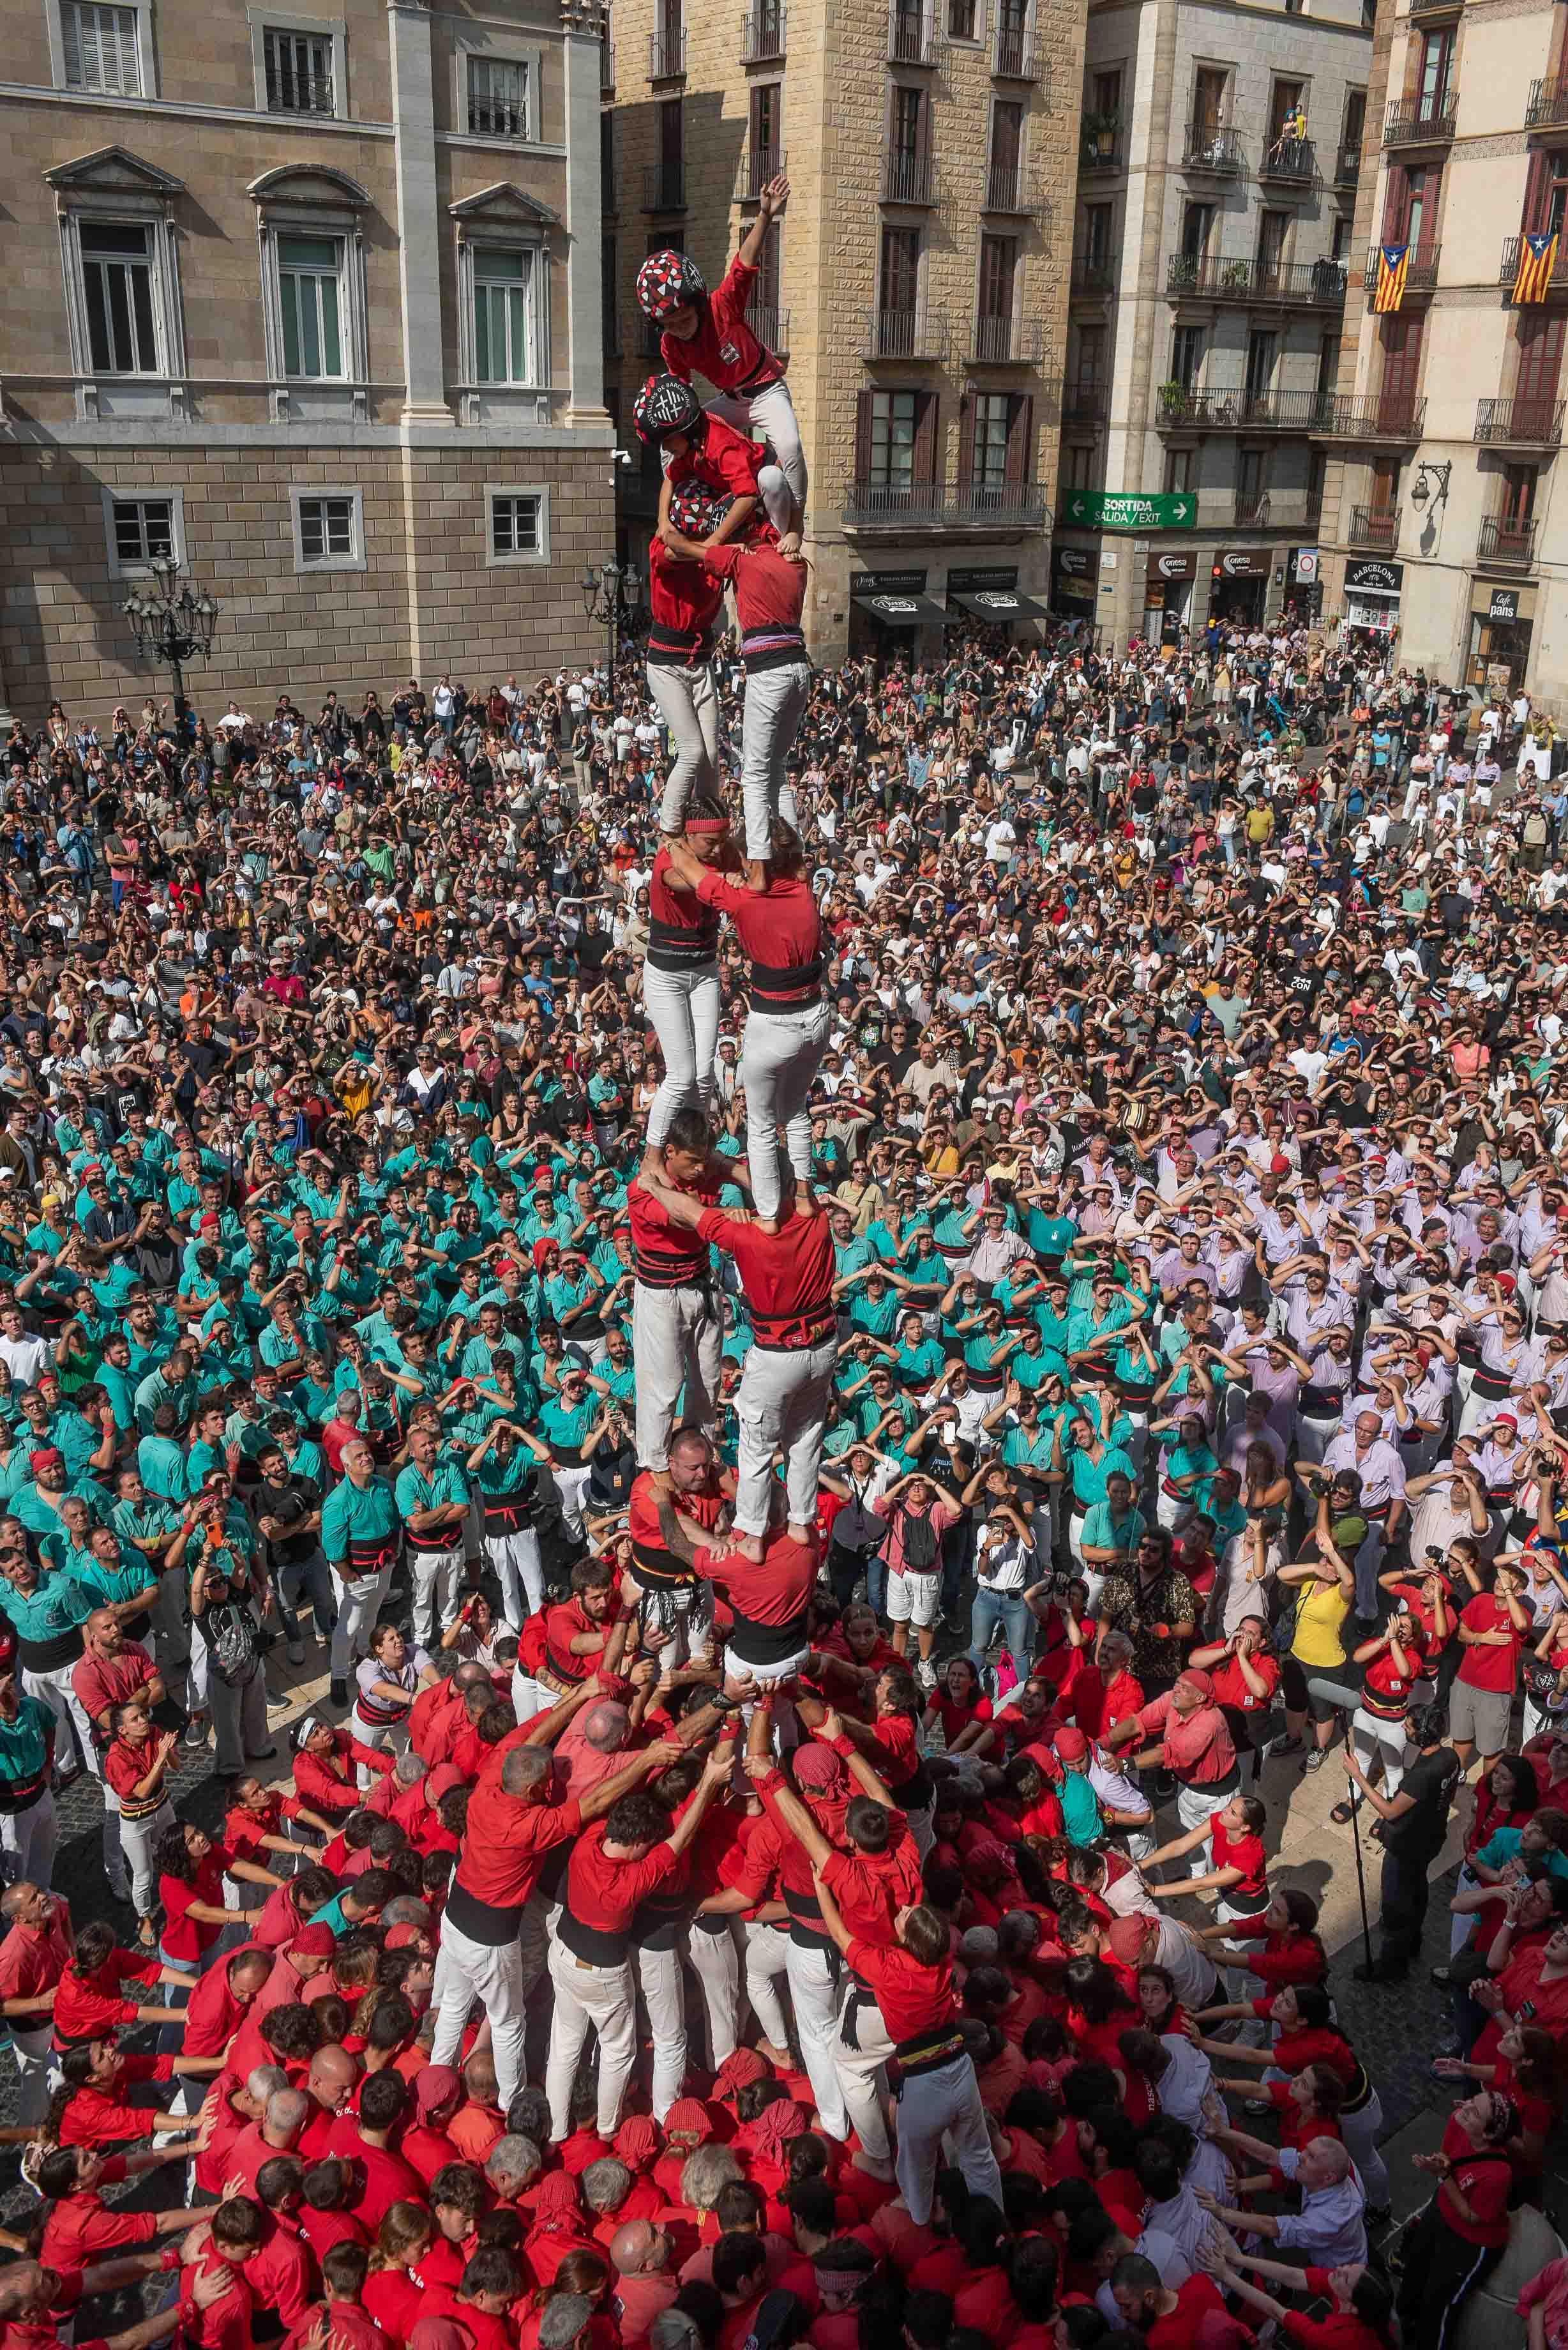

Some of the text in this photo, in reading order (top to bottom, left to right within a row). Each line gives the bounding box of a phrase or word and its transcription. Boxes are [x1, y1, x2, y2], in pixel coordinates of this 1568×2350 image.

[647, 382, 690, 428] CASTELLERS DE BARCELONA
[1103, 499, 1152, 512] SORTIDA
[1094, 511, 1128, 522] SALIDA
[1138, 513, 1161, 523] EXIT
[1353, 565, 1396, 587] BARCELONA
[1489, 605, 1514, 618] pans
[1291, 982, 1310, 990] CON
